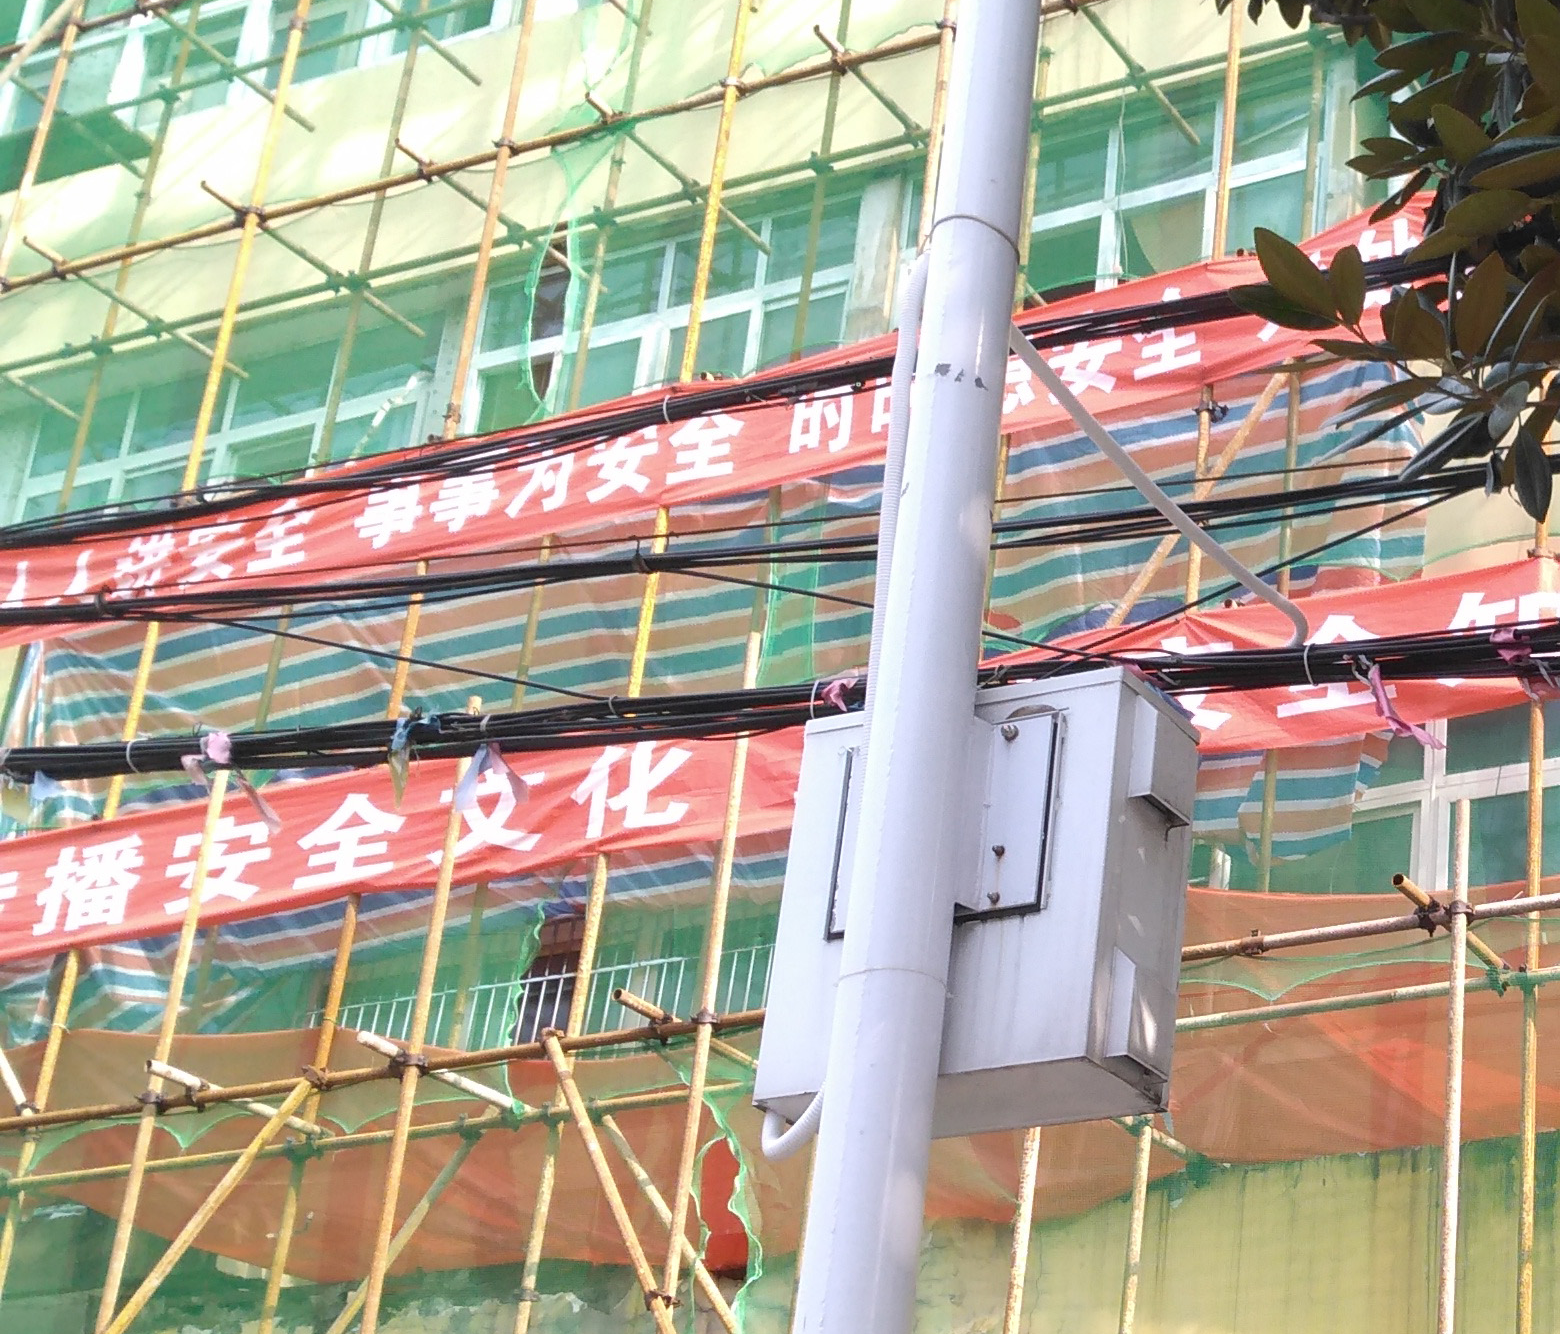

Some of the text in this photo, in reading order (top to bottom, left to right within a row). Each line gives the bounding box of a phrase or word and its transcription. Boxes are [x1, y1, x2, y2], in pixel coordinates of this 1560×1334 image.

[0, 740, 693, 935] 播安全文化
